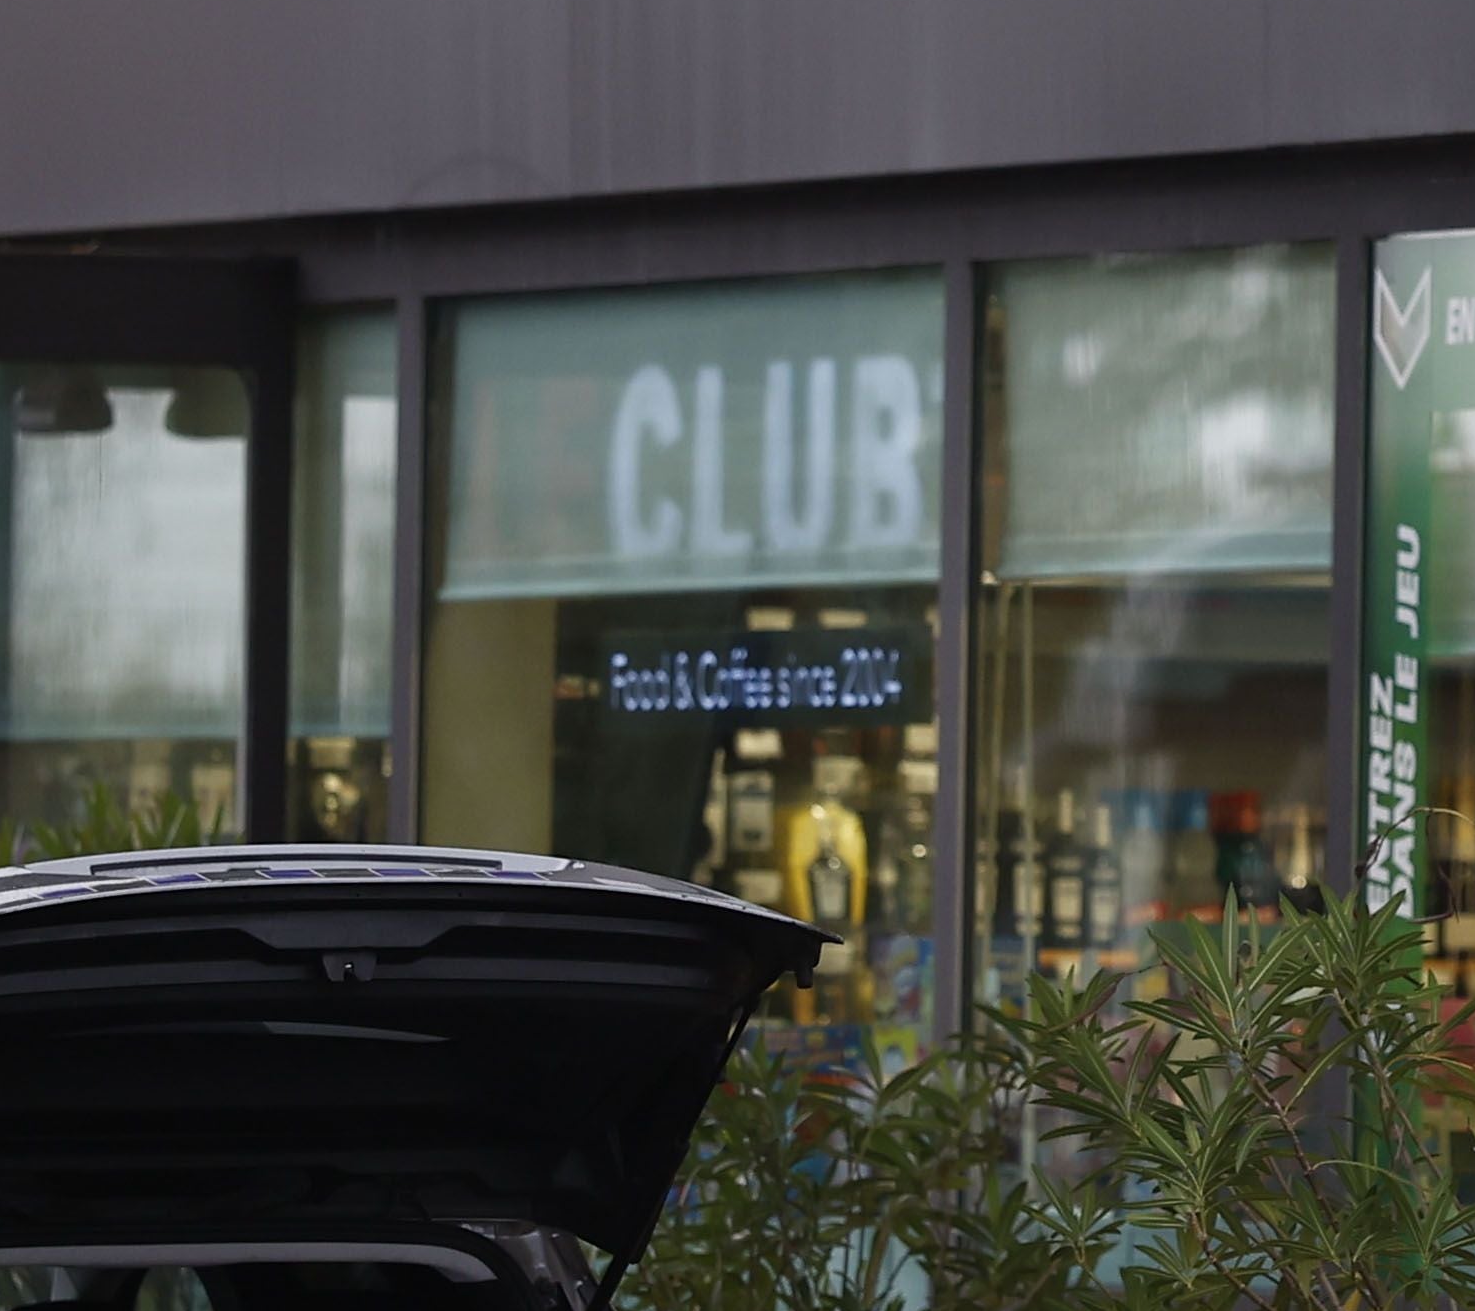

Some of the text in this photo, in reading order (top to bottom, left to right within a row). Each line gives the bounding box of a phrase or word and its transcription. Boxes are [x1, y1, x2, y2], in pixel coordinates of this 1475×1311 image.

[606, 353, 924, 557] CLUB
[1366, 672, 1395, 918] ENTREZ
[1391, 523, 1421, 920] DANS LE JEU
